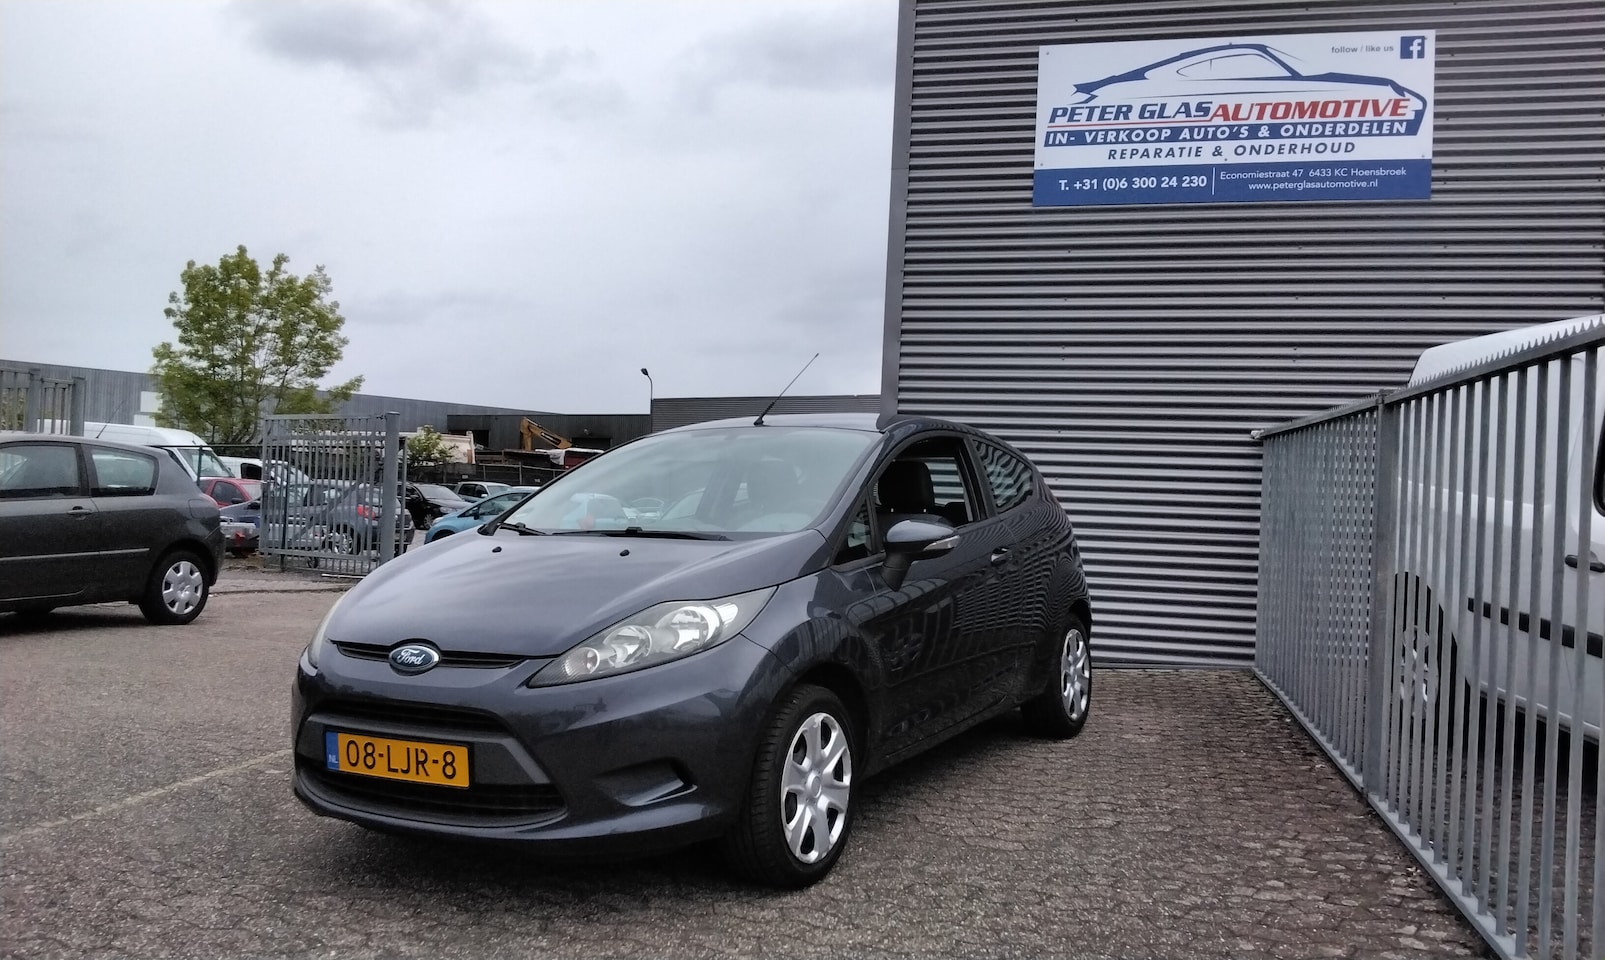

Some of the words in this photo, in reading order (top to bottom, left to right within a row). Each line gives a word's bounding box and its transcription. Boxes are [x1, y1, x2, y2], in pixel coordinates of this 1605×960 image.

[1331, 46, 1358, 54] follow
[1365, 45, 1381, 53] like
[1048, 104, 1133, 124] PETER
[1048, 132, 1076, 145] IN-
[1085, 129, 1172, 143] VERKOOP
[1178, 125, 1249, 141] AUTO'S
[1257, 125, 1270, 138] &
[1280, 121, 1408, 137] ONDERDELEN
[1108, 146, 1203, 160] REPARATIE
[1211, 145, 1223, 157] &
[1233, 141, 1356, 157] ONDERHOUD
[1220, 170, 1290, 180] Economiestraat
[1292, 168, 1304, 178] 47
[1308, 168, 1332, 177] 6433
[1334, 167, 1348, 177] KC
[1351, 167, 1407, 177] Hoensbroek
[1059, 179, 1070, 191] T.
[1073, 178, 1098, 190] +31
[1102, 177, 1128, 191] (0)6
[1131, 176, 1157, 189] 300
[1161, 176, 1178, 188] 24
[1181, 175, 1208, 188] 230
[1248, 179, 1378, 191] www.peterglasautomotive.nl
[397, 649, 426, 665] Ford
[346, 739, 457, 780] 08-LJR-8
